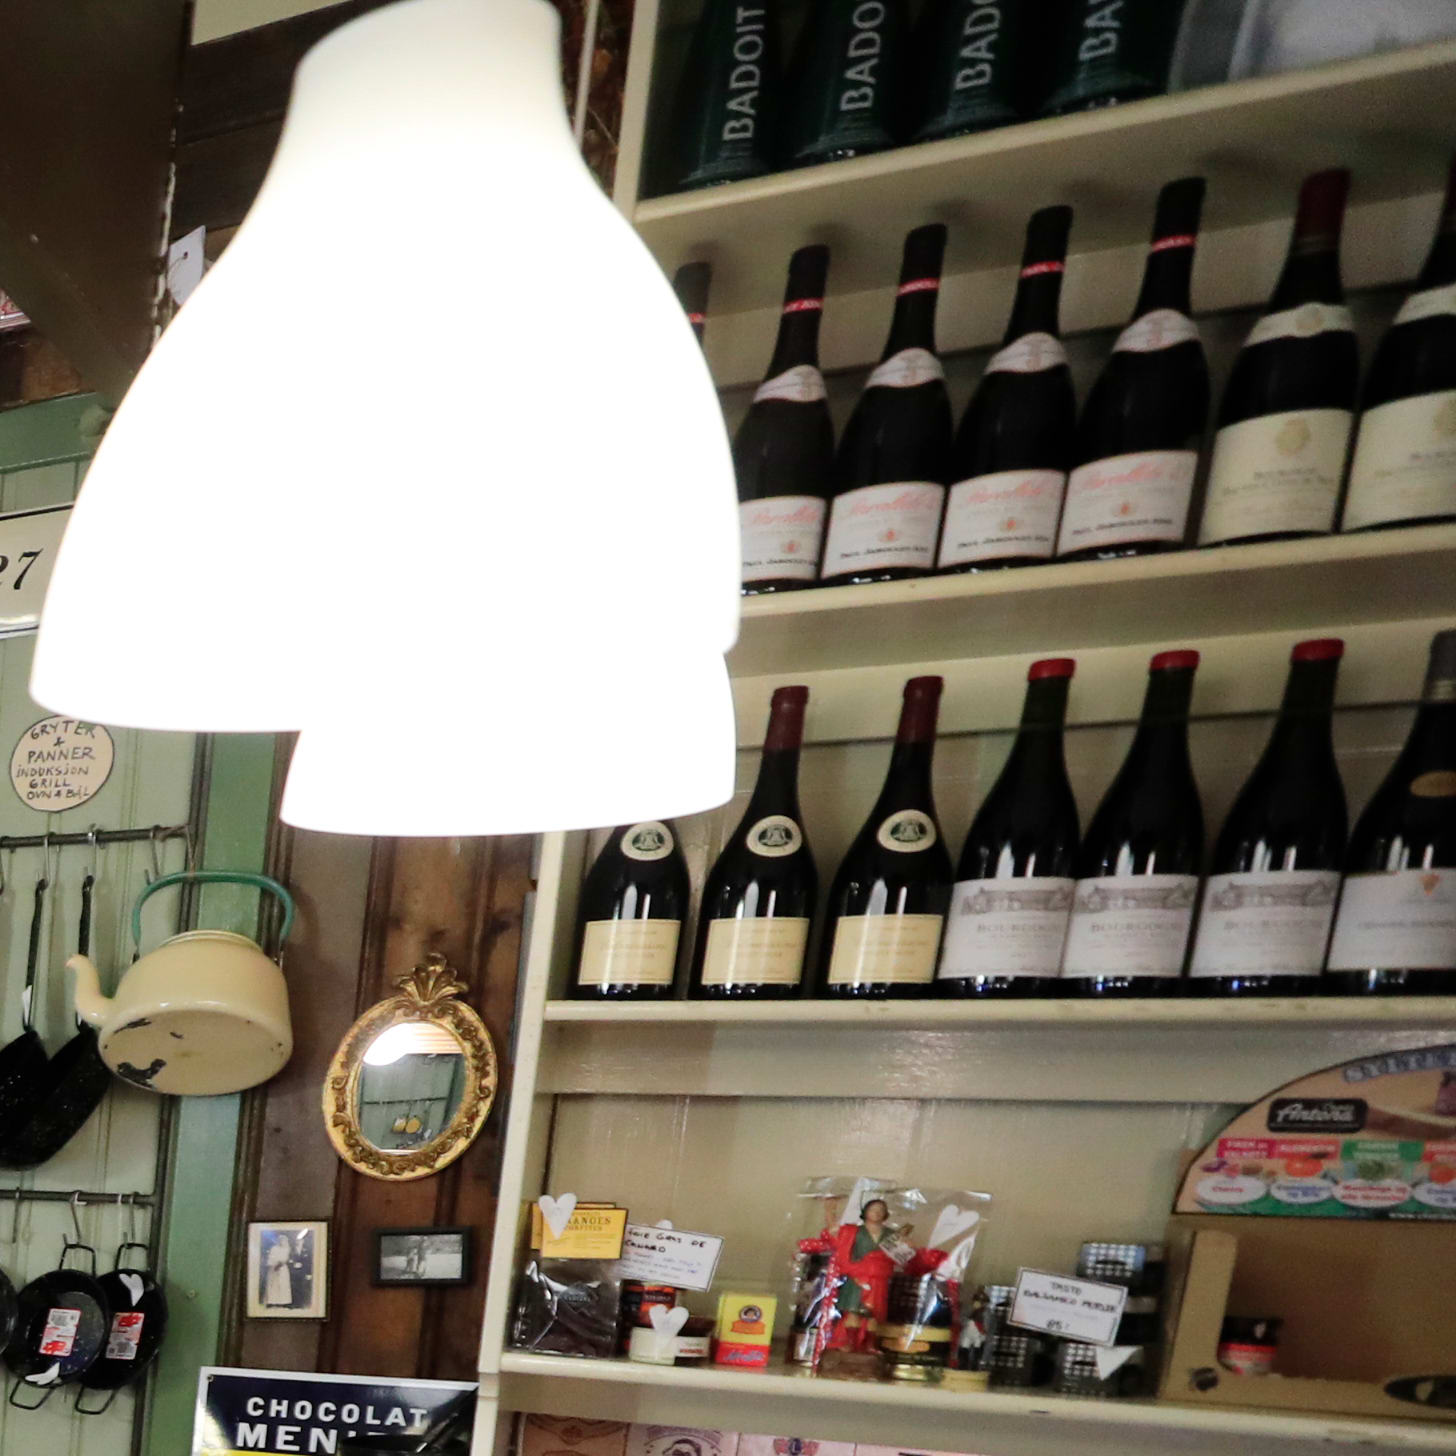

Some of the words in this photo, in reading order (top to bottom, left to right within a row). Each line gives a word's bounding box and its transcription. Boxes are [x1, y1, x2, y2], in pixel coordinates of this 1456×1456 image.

[723, 6, 766, 141] BADOIT
[28, 746, 96, 764] PANNER
[29, 778, 71, 789] GRILL
[27, 790, 51, 800] OVN
[246, 1397, 428, 1428] CHOCOLAT
